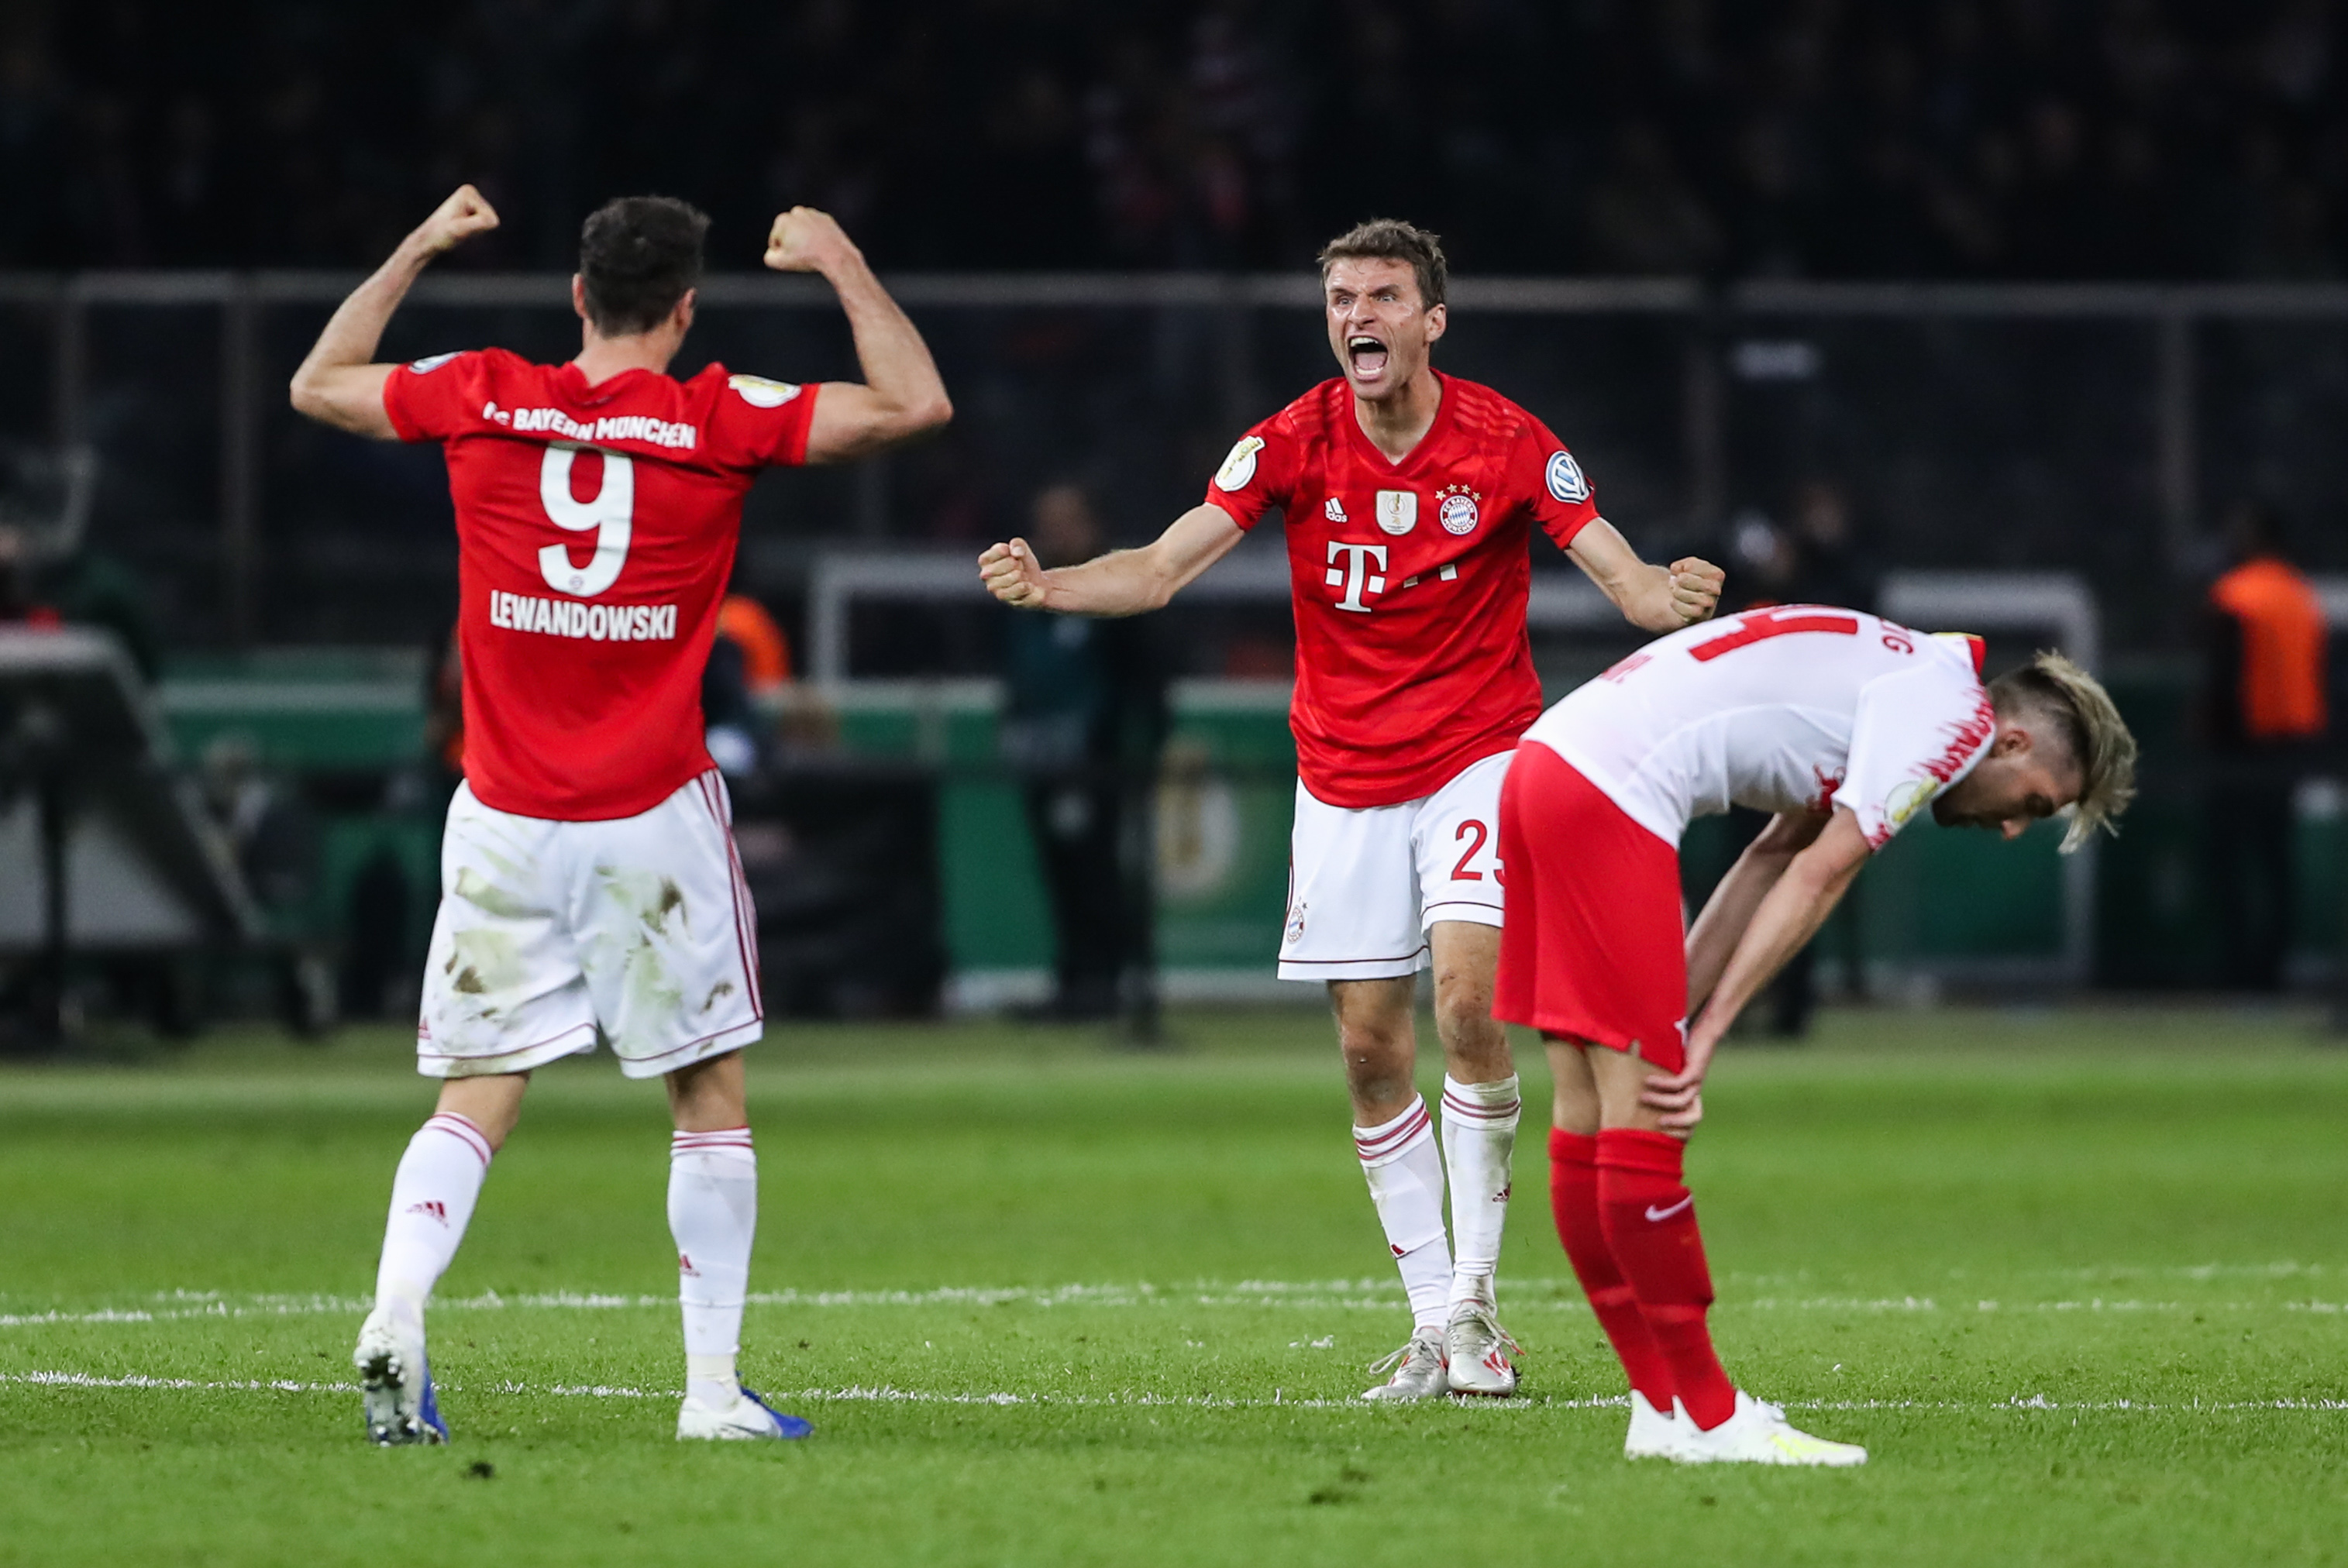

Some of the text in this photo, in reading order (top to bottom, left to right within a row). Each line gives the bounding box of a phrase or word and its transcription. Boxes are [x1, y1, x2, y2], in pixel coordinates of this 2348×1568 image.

[513, 408, 594, 441] BAYERN
[538, 440, 635, 597] 9
[491, 590, 677, 641] LEWANDOWSKI
[1451, 819, 1506, 888] 2
